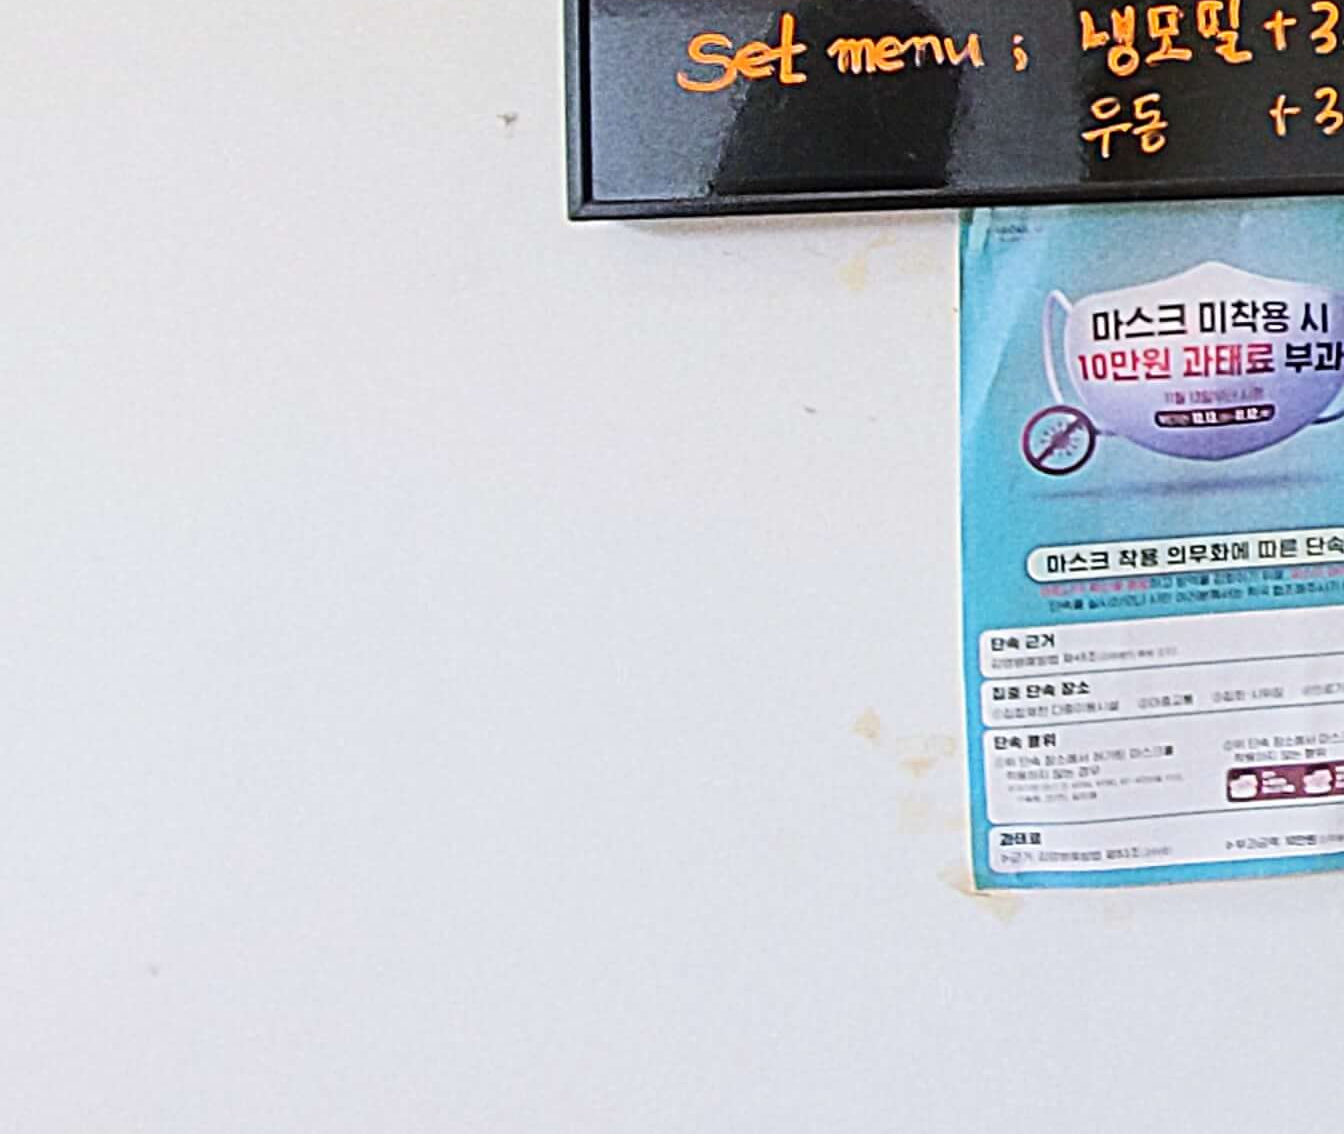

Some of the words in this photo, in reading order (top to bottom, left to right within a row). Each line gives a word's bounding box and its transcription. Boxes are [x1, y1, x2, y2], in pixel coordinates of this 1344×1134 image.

[678, 14, 806, 92] Set
[1080, 92, 1169, 160] 우동
[1092, 304, 1188, 342] 마스크
[1199, 300, 1290, 335] 미착용
[1301, 302, 1328, 333] 시
[1078, 348, 1172, 383] 10만원
[1183, 342, 1276, 379] 과태료
[1284, 341, 1344, 373] 부과
[1047, 551, 1110, 573] 마스크
[1306, 536, 1344, 556] 단속
